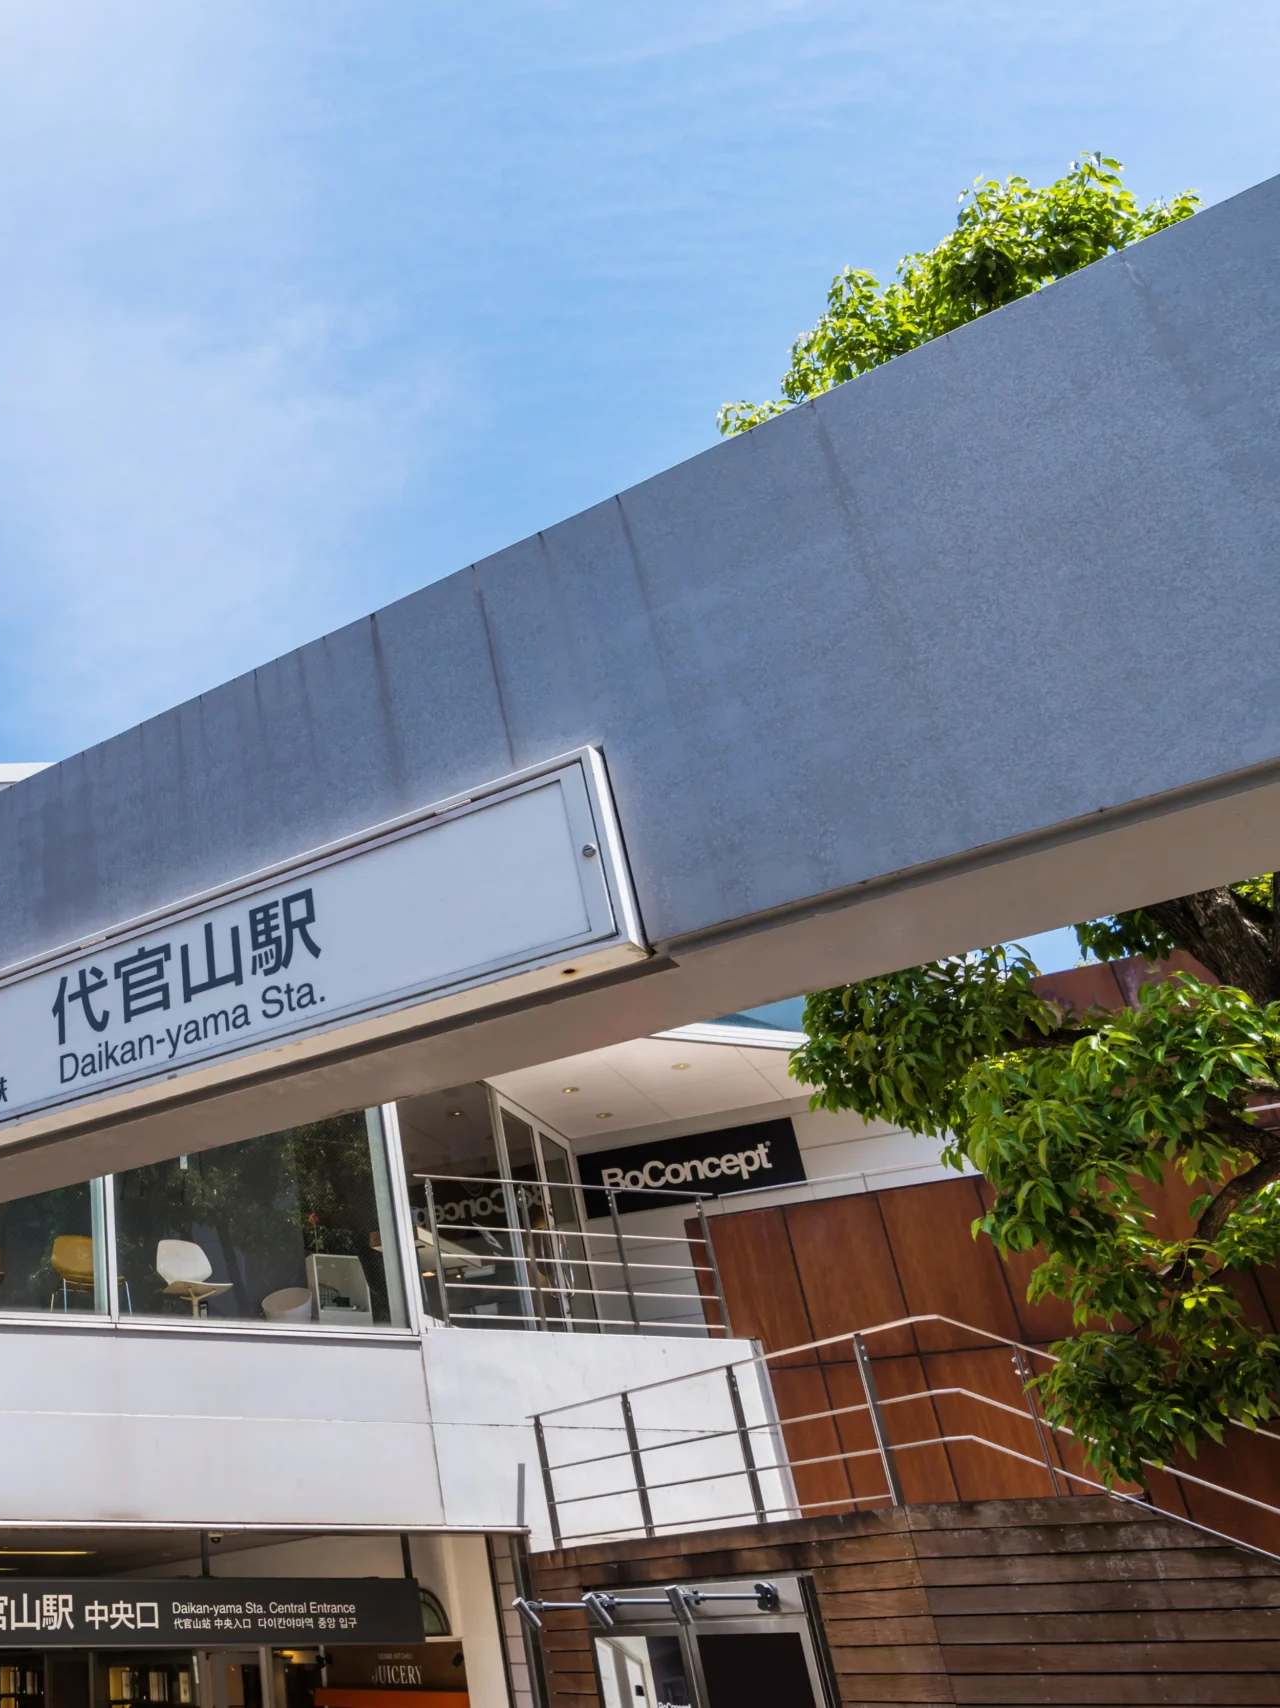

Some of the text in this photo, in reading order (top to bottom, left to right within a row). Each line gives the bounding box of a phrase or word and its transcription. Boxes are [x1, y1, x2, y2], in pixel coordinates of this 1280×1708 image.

[52, 888, 321, 1045] 代官山駅
[60, 981, 325, 1084] Daikan-yama Sta.
[601, 1143, 773, 1194] BoConcept
[84, 1600, 159, 1630] 中央口
[172, 1601, 356, 1617] Daikan-yama Sta. Central Entrance
[174, 1617, 252, 1629] 代官山站 中央入口
[258, 1617, 357, 1629] 다이칸야마역 중앙 입구
[371, 1665, 422, 1685] JUICERY
